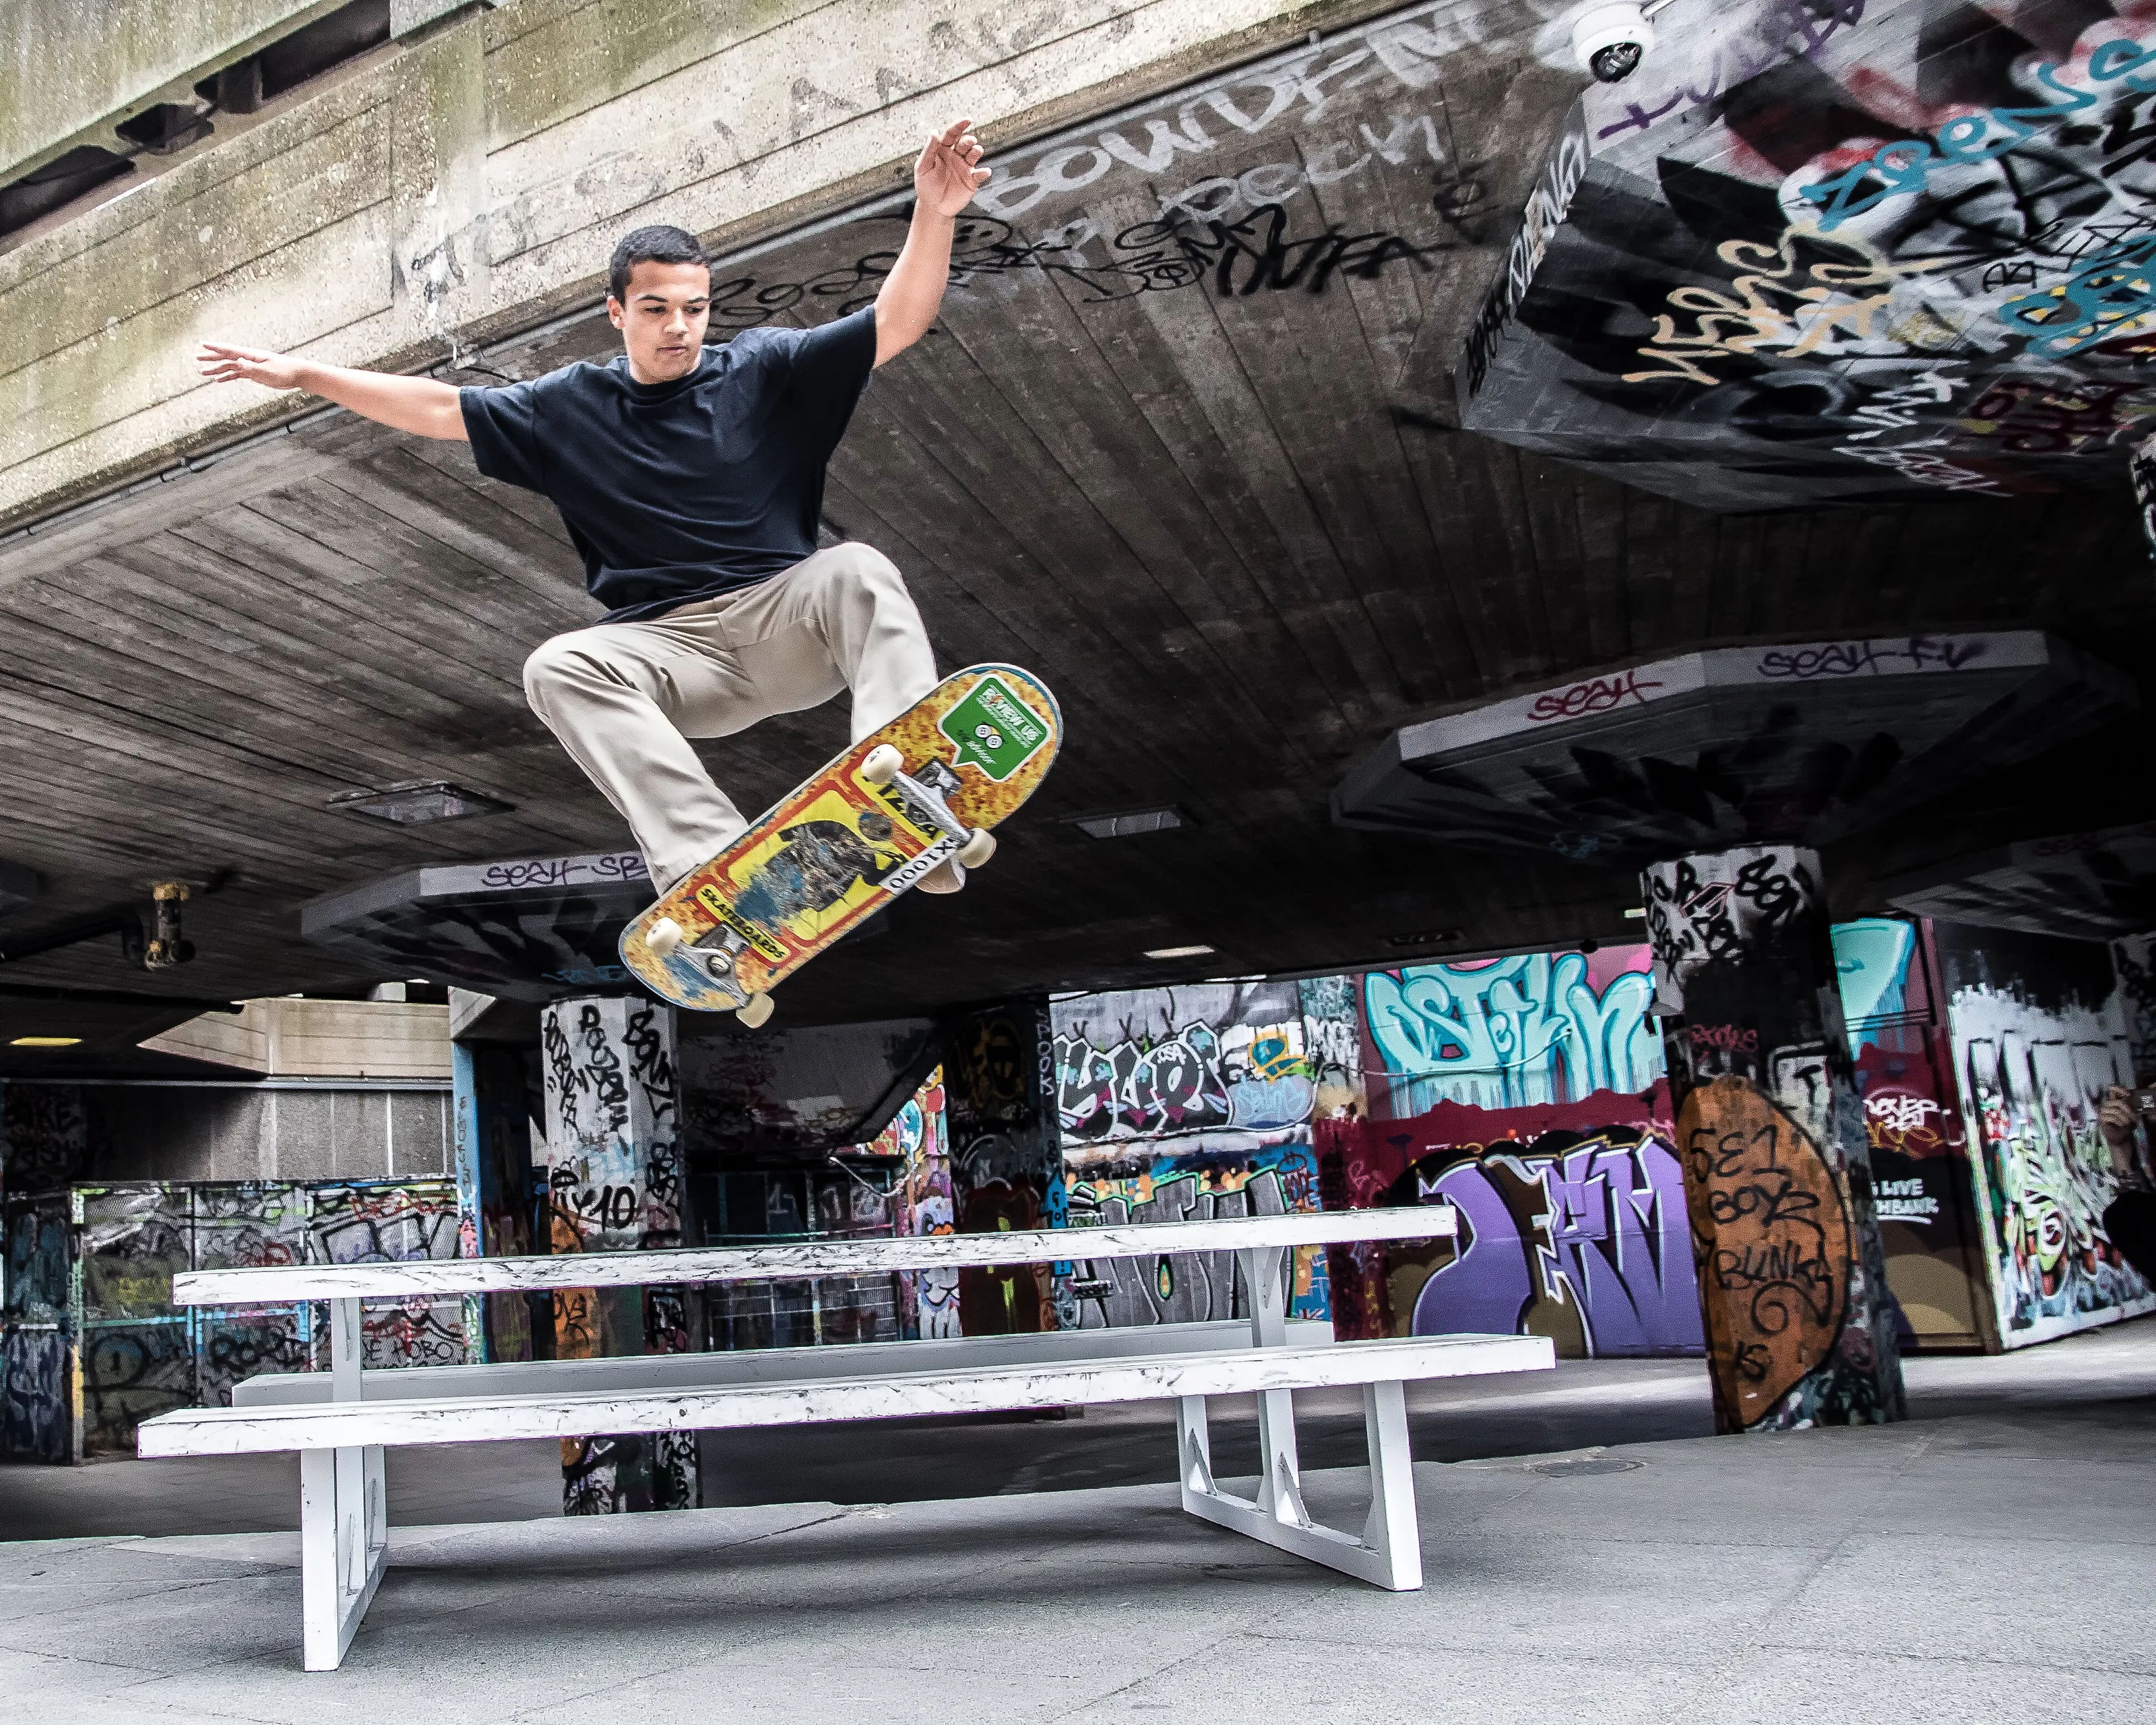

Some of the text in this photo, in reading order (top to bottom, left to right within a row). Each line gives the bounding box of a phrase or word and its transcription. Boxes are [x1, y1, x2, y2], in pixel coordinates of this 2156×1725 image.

[699, 887, 786, 959] SKATEBOARDS
[1881, 1179, 1924, 1196] LIVE
[1876, 1196, 1940, 1214] HBANK
